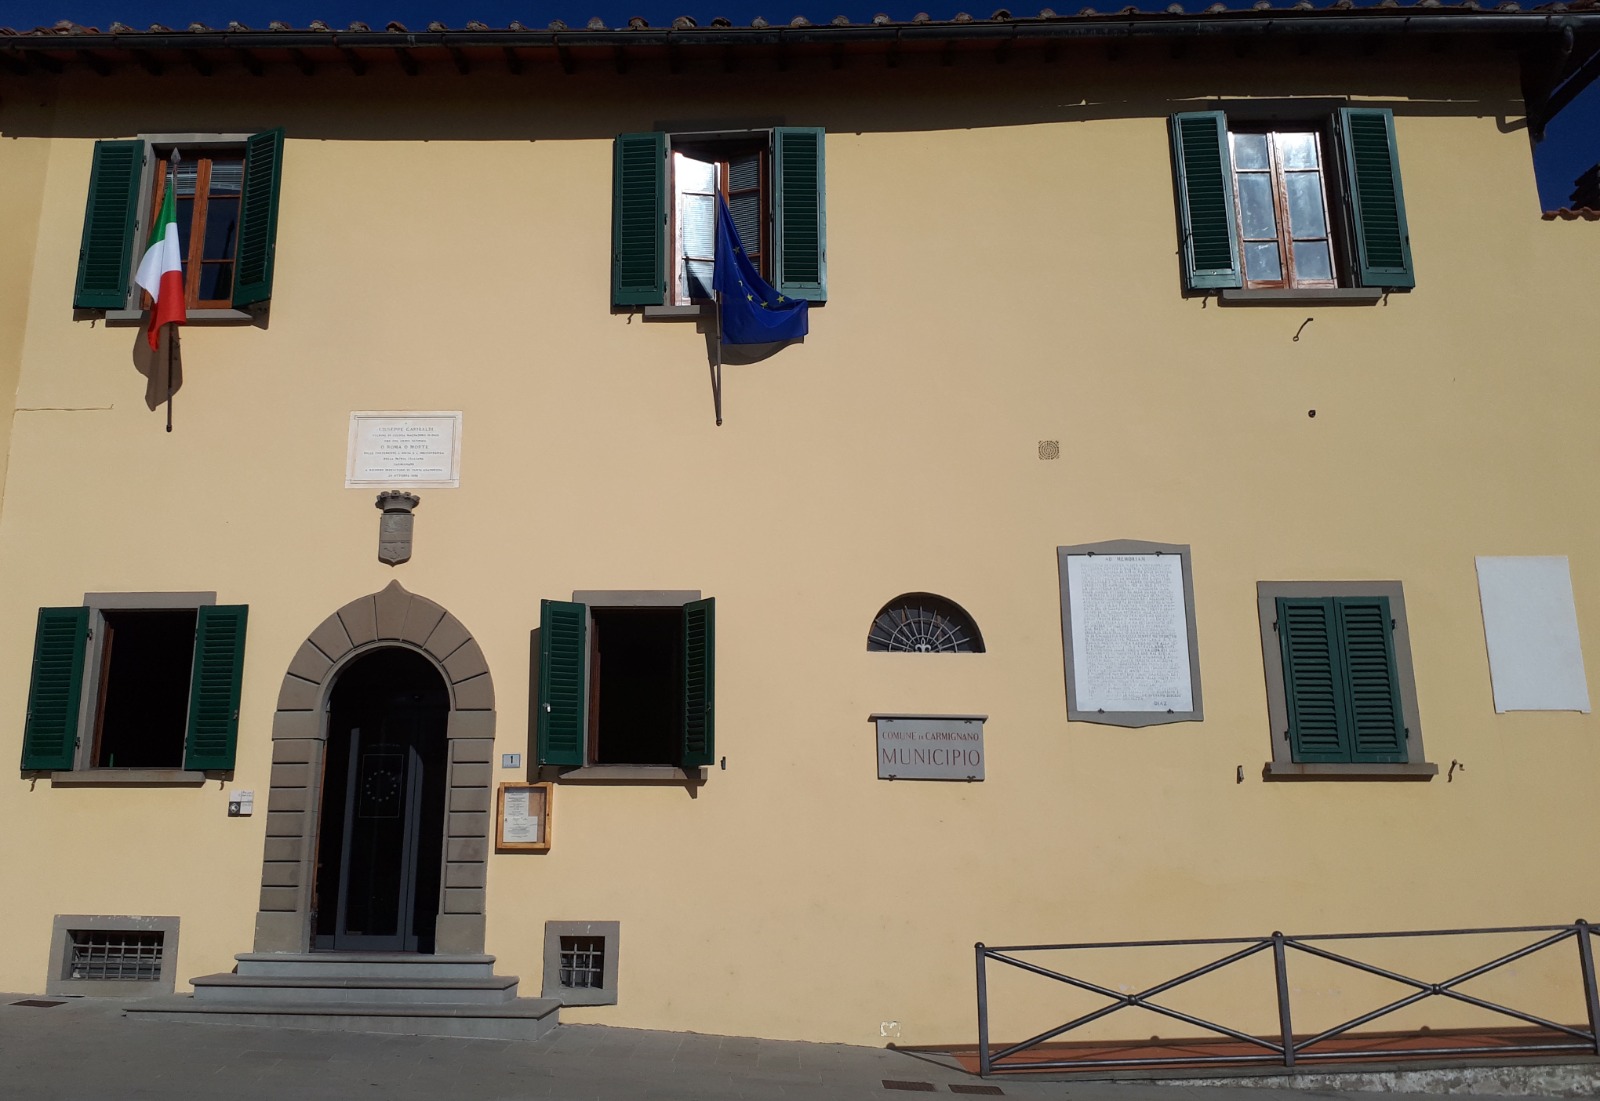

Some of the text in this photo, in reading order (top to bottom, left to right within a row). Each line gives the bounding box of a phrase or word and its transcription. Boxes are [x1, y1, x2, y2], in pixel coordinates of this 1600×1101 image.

[882, 731, 917, 740] COMUNE
[925, 731, 980, 741] CARMIGNANO
[882, 747, 981, 767] MUNICIPIO
